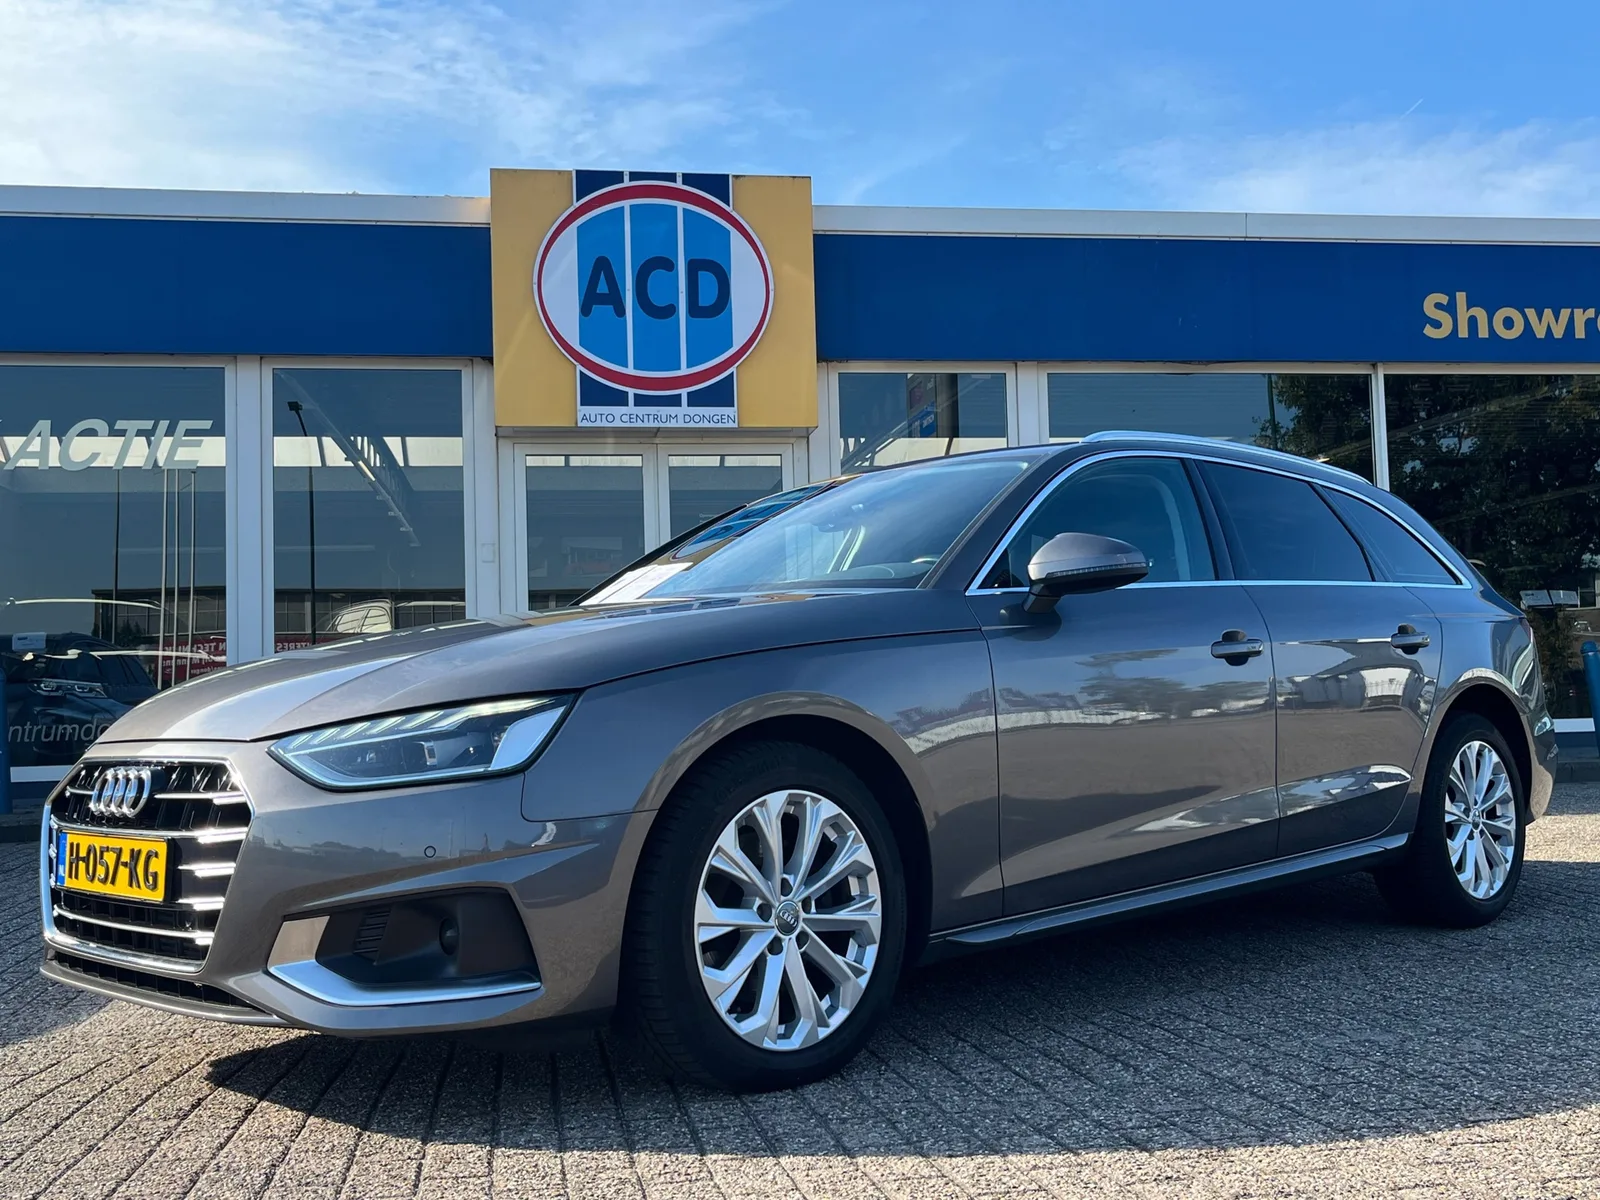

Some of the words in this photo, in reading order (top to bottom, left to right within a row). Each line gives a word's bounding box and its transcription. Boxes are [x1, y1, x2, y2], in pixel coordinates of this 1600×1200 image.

[580, 255, 731, 320] ACD
[1422, 291, 1600, 340] Showr
[580, 413, 616, 424] AUTO
[619, 413, 678, 424] CENTRUM
[682, 413, 736, 425] DONGEN
[3, 418, 213, 472] ACTIE
